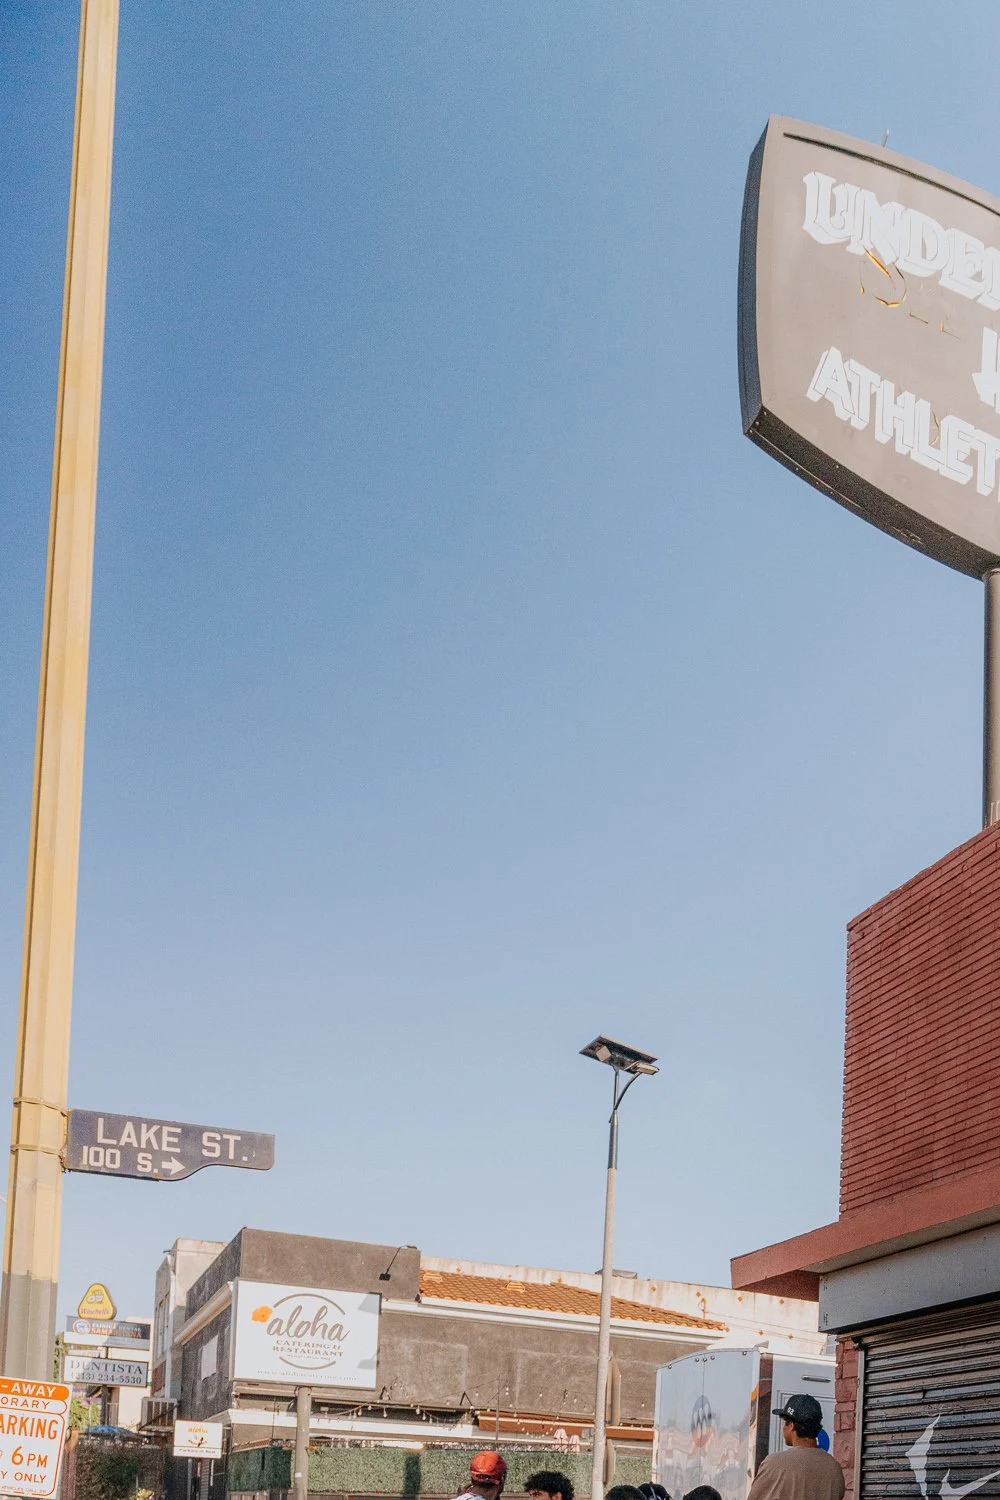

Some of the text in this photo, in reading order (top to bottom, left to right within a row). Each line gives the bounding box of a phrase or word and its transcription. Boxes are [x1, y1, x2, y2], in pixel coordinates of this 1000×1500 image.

[97, 1117, 249, 1162] LAKE ST.
[81, 1145, 159, 1174] 100 S.
[267, 1305, 350, 1342] aloha
[276, 1339, 329, 1350] CATERING
[273, 1346, 344, 1358] RESTAURANT
[71, 1360, 143, 1375] DENTISTA
[98, 1373, 142, 1385] 234-5530
[14, 1472, 47, 1484] ONLY
